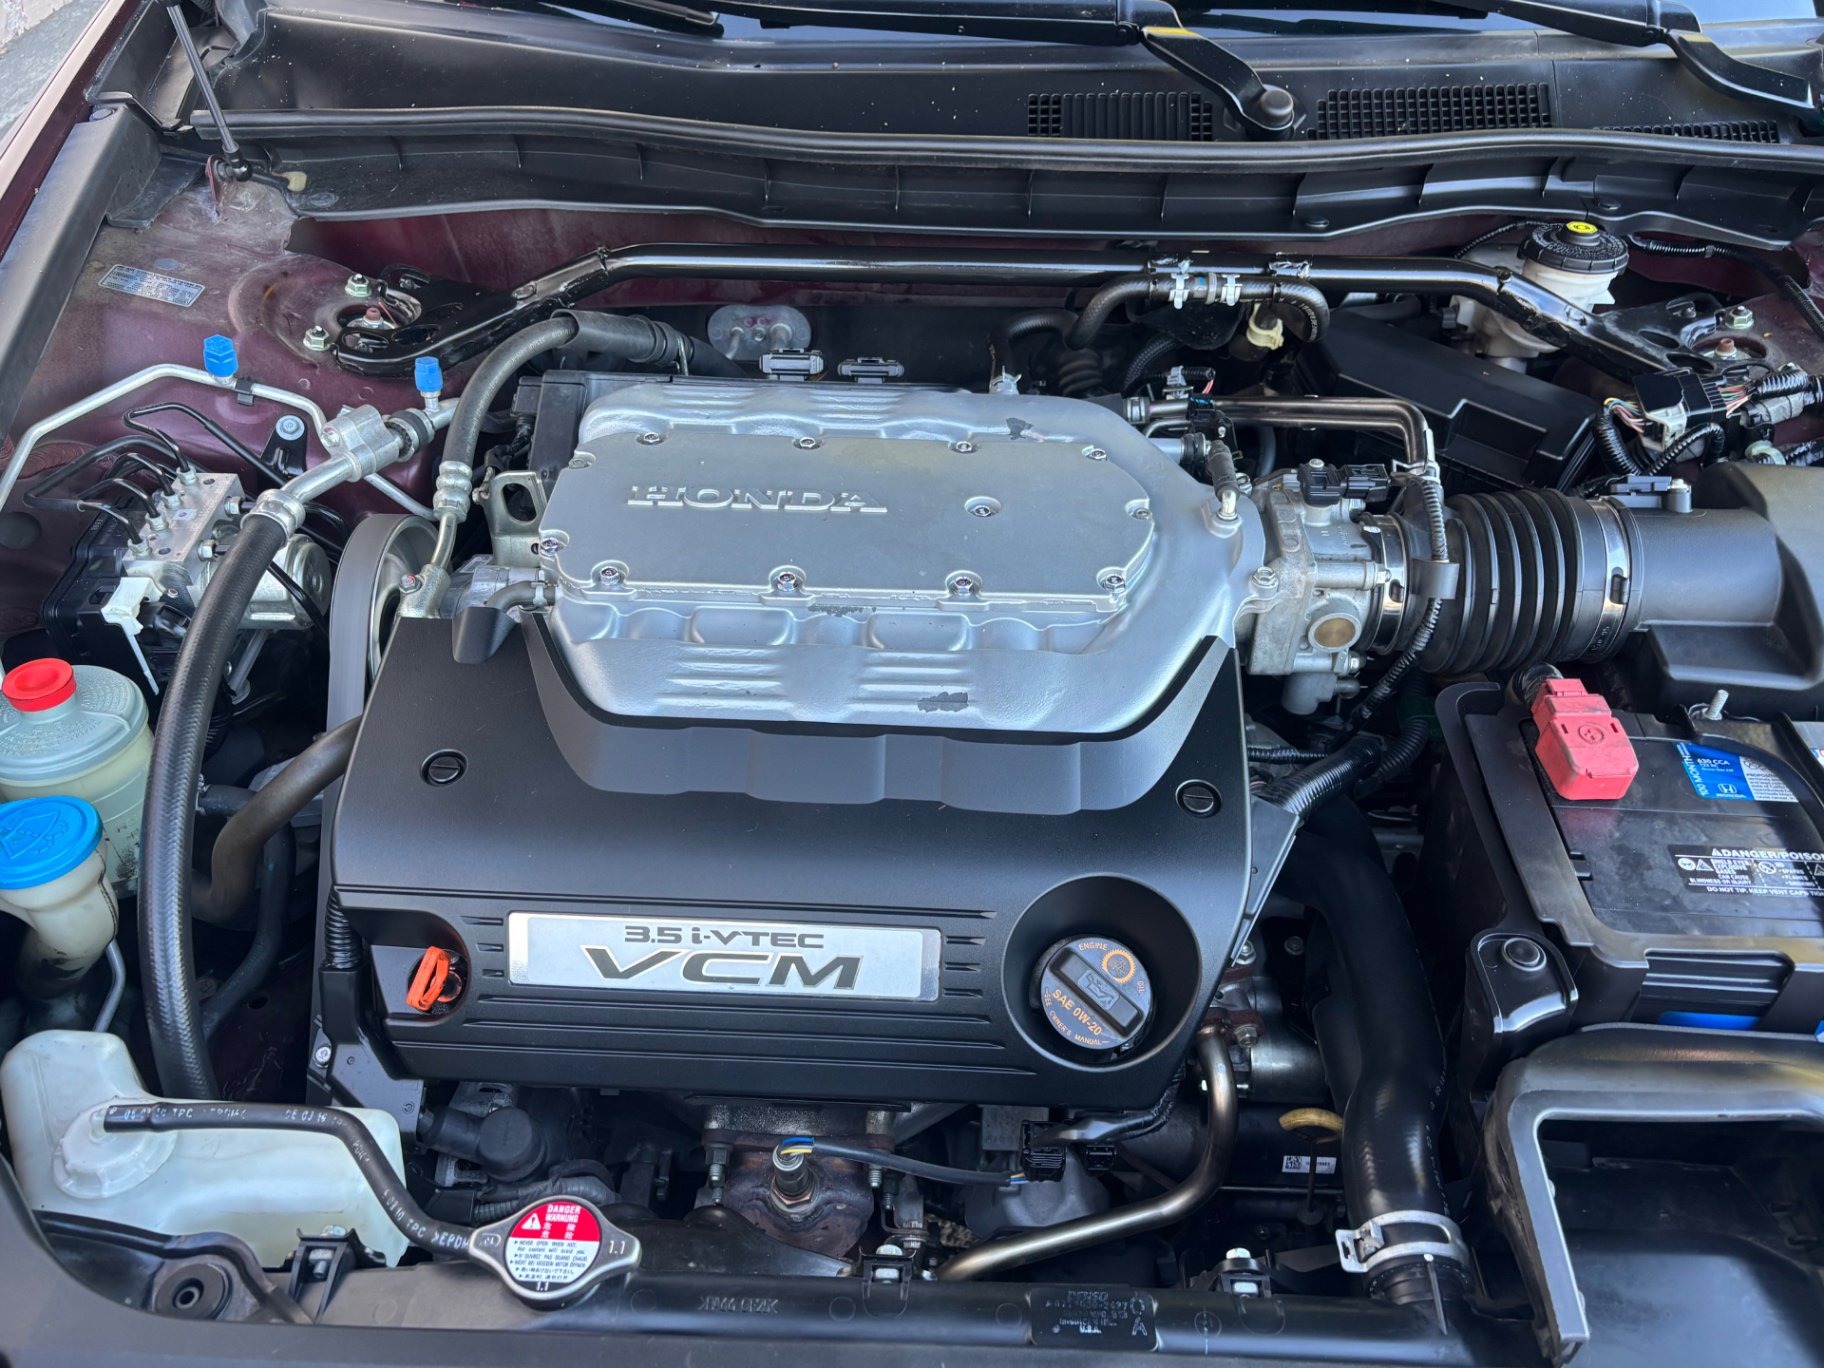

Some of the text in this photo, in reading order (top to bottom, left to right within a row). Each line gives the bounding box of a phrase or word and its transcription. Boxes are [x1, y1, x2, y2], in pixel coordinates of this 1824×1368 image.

[627, 485, 888, 512] HONDA
[625, 925, 824, 949] 3.5 i-VTEC
[1078, 941, 1108, 951] ENGINE
[580, 945, 864, 991] VCM
[1136, 980, 1145, 993] OIL
[1052, 989, 1102, 1036] SAE 0W-20
[1074, 1033, 1102, 1045] MANUAL
[547, 1204, 581, 1214] DANGER
[545, 1213, 579, 1223] WARNUNG
[406, 1218, 426, 1238] TPC
[608, 1239, 626, 1255] 1.1
[536, 1281, 550, 1292] 1.1
